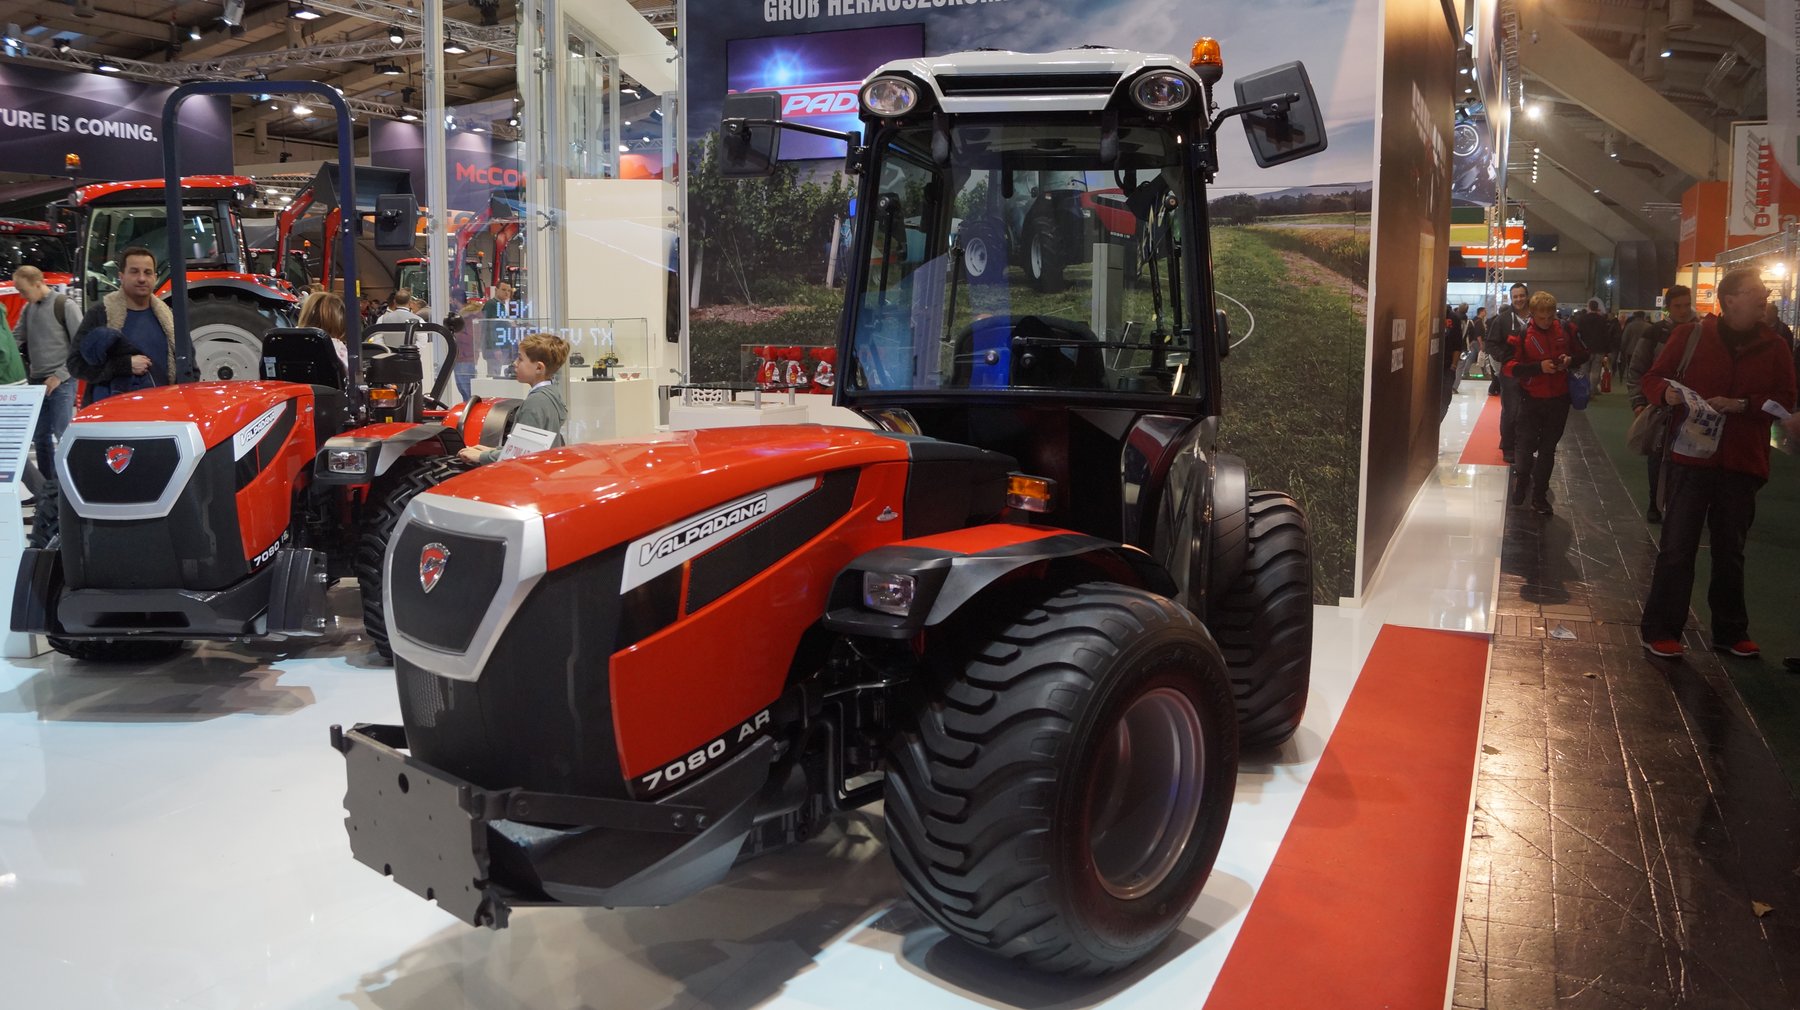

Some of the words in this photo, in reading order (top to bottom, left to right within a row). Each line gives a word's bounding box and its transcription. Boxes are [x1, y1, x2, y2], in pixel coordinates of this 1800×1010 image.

[783, 92, 859, 114] PAD
[0, 108, 46, 130] URE
[51, 114, 70, 133] IS
[75, 117, 158, 142] COMING.
[240, 409, 276, 446] VALPADANA
[639, 493, 768, 566] VALPADANA
[253, 540, 280, 567] 7080
[642, 738, 726, 791] 7080
[737, 709, 770, 742] AR
